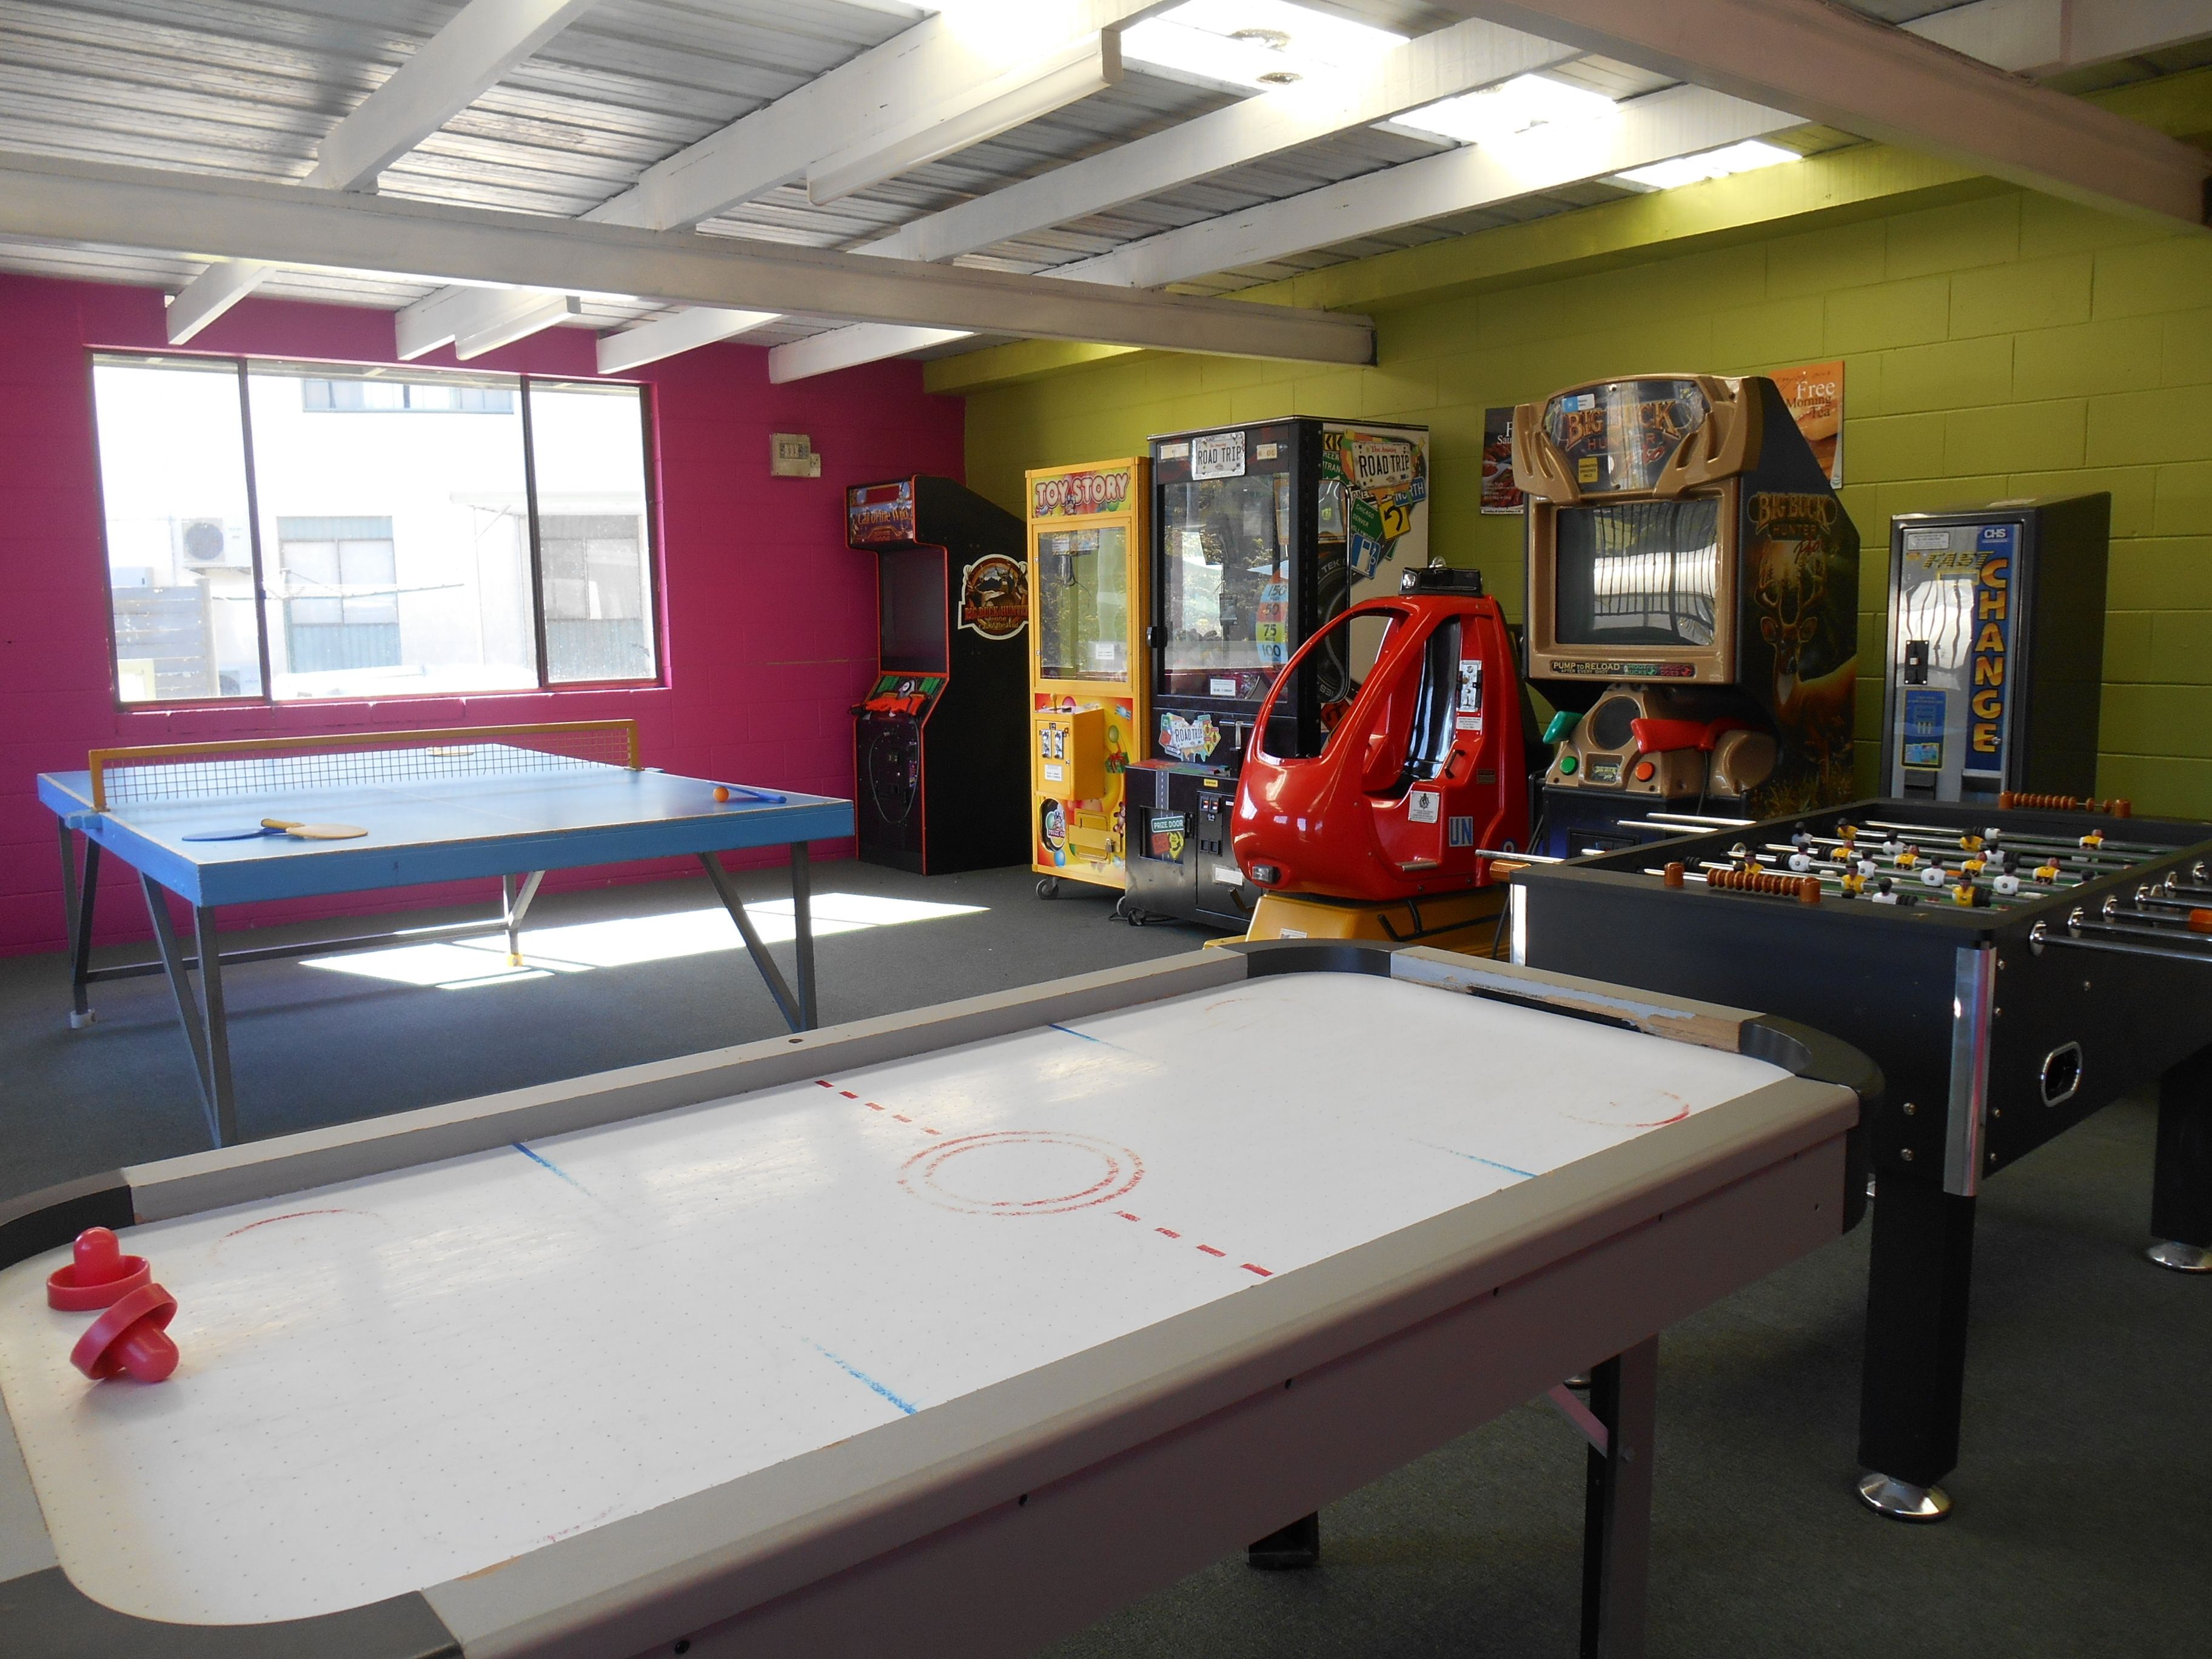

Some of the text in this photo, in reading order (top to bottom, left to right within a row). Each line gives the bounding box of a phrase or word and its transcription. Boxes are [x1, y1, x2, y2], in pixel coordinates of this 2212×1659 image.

[1796, 381, 1835, 399] Free
[1786, 396, 1831, 409] Morning
[1809, 407, 1830, 418] Tea
[1566, 400, 1681, 451] BIG CK
[1198, 449, 1218, 465] ROAD
[1221, 446, 1241, 463] TRIP
[1359, 454, 1410, 478] ROAD TRIP
[1036, 472, 1128, 508] TOY STORY
[858, 512, 870, 525] Call
[879, 510, 890, 523] the
[893, 508, 908, 521] Wild
[1356, 504, 1374, 519] CHICAGO
[1756, 492, 1831, 535] BIG BUCK
[1353, 514, 1369, 528] DENVER
[1774, 525, 1817, 535] HUNTER
[1984, 528, 2006, 538] CHS
[1321, 558, 1339, 573] TEK
[1922, 551, 1995, 569] FAST
[1269, 585, 1286, 596] 150
[965, 605, 1028, 620] BIG BUCK HUNTE
[1264, 624, 1276, 637] 75
[1262, 645, 1281, 657] 100
[1972, 557, 2009, 753] CHANGE
[1175, 728, 1203, 742] ROAD TRIP
[1154, 821, 1168, 830] PRIZE
[1450, 819, 1473, 845] UN
